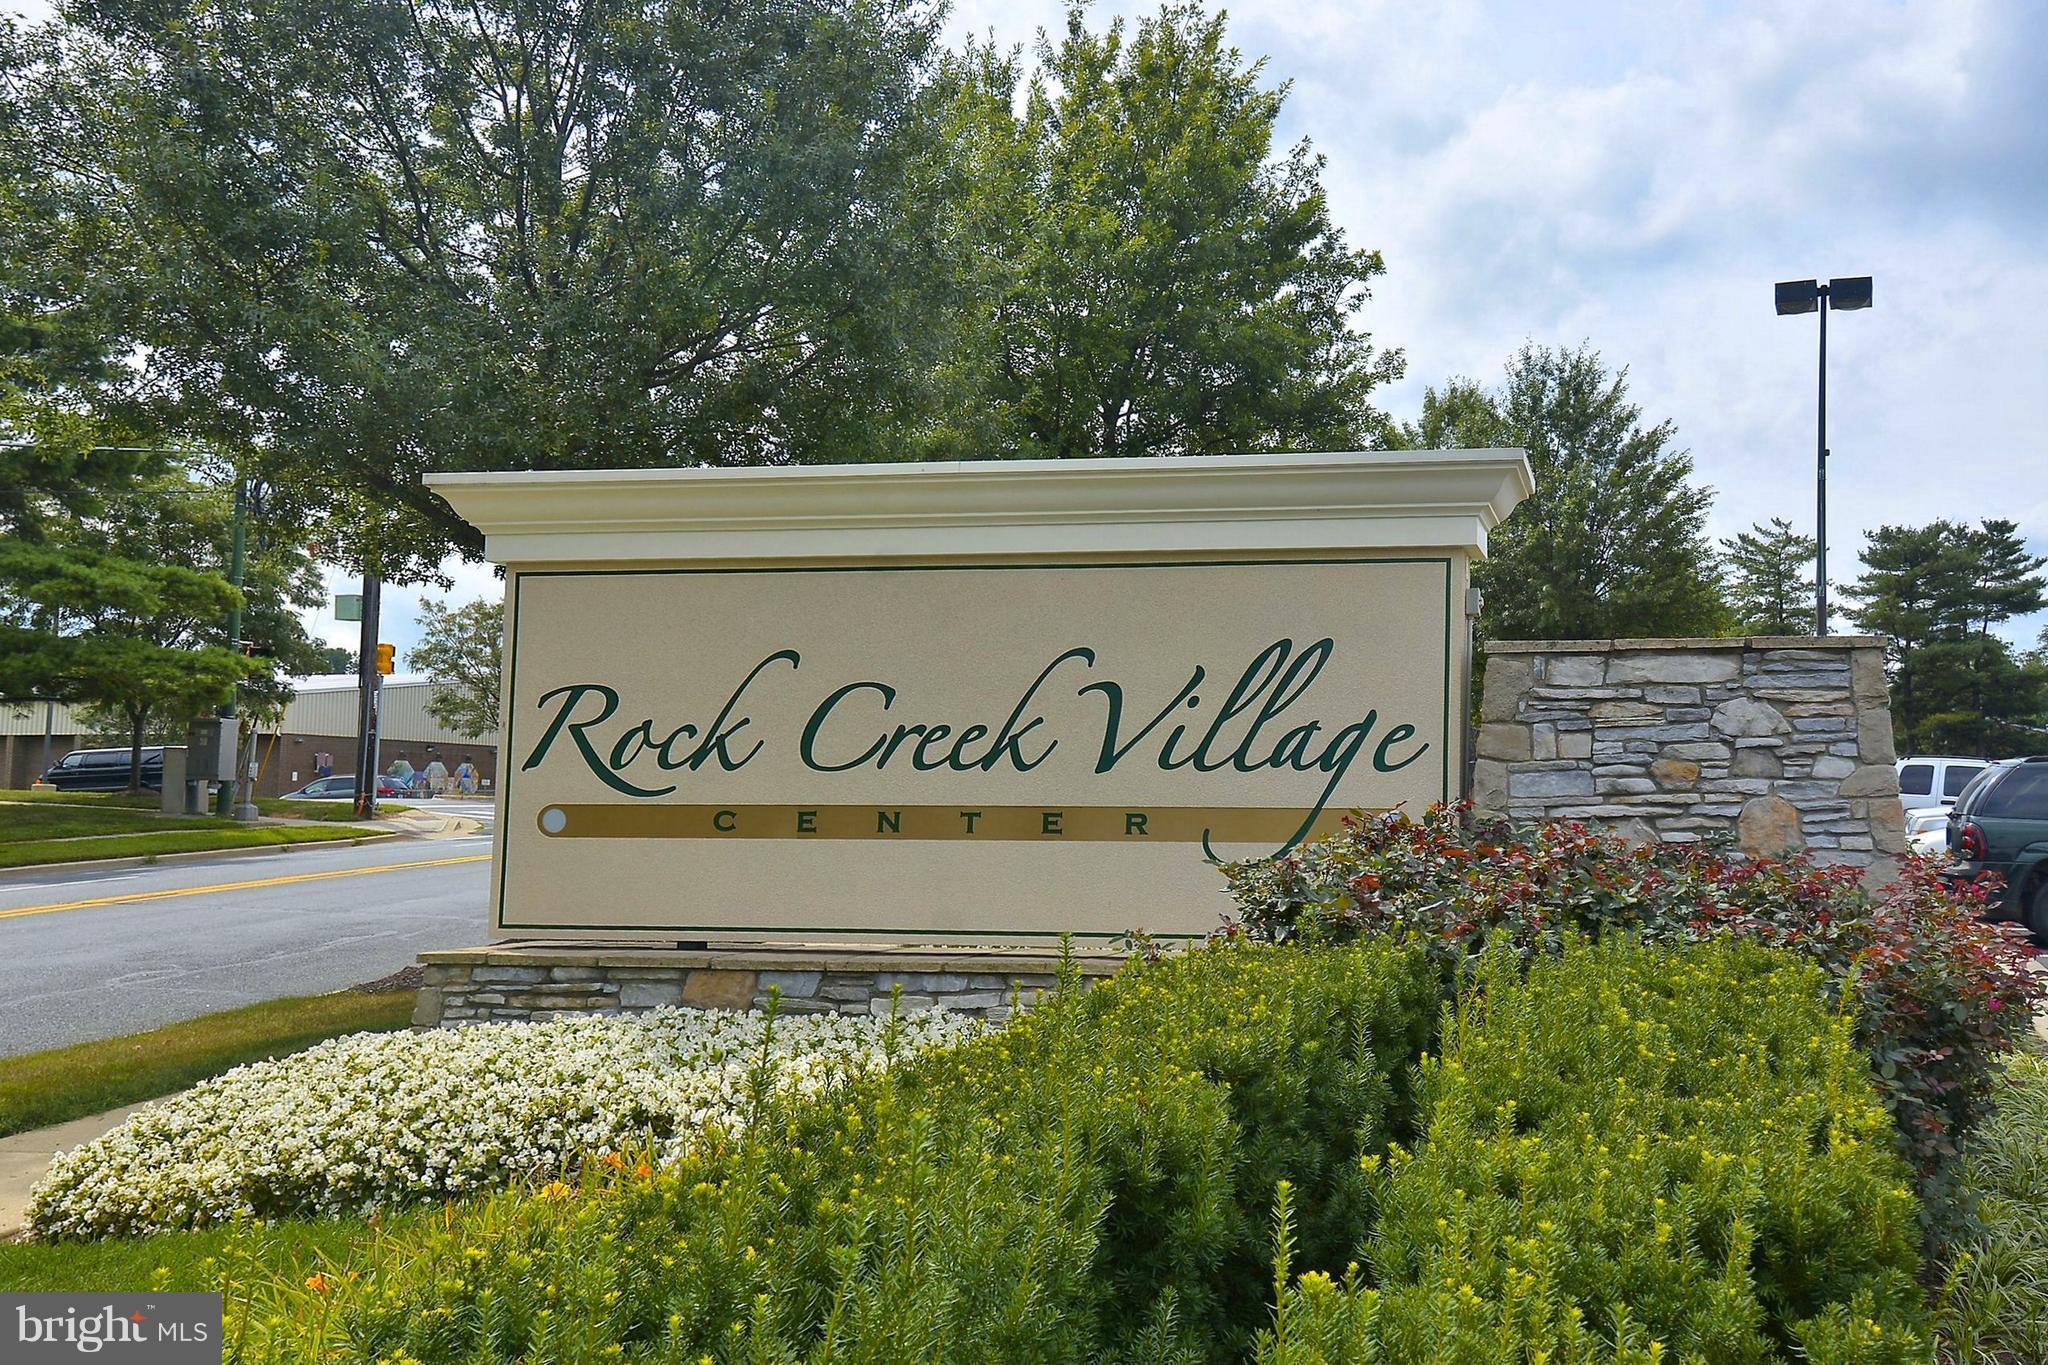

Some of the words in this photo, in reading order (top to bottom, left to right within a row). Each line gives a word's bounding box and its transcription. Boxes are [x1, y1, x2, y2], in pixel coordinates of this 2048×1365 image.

[522, 648, 800, 798] Rock
[799, 647, 1096, 773] Creek
[1077, 637, 1430, 863] Village
[712, 810, 1149, 836] CENTER
